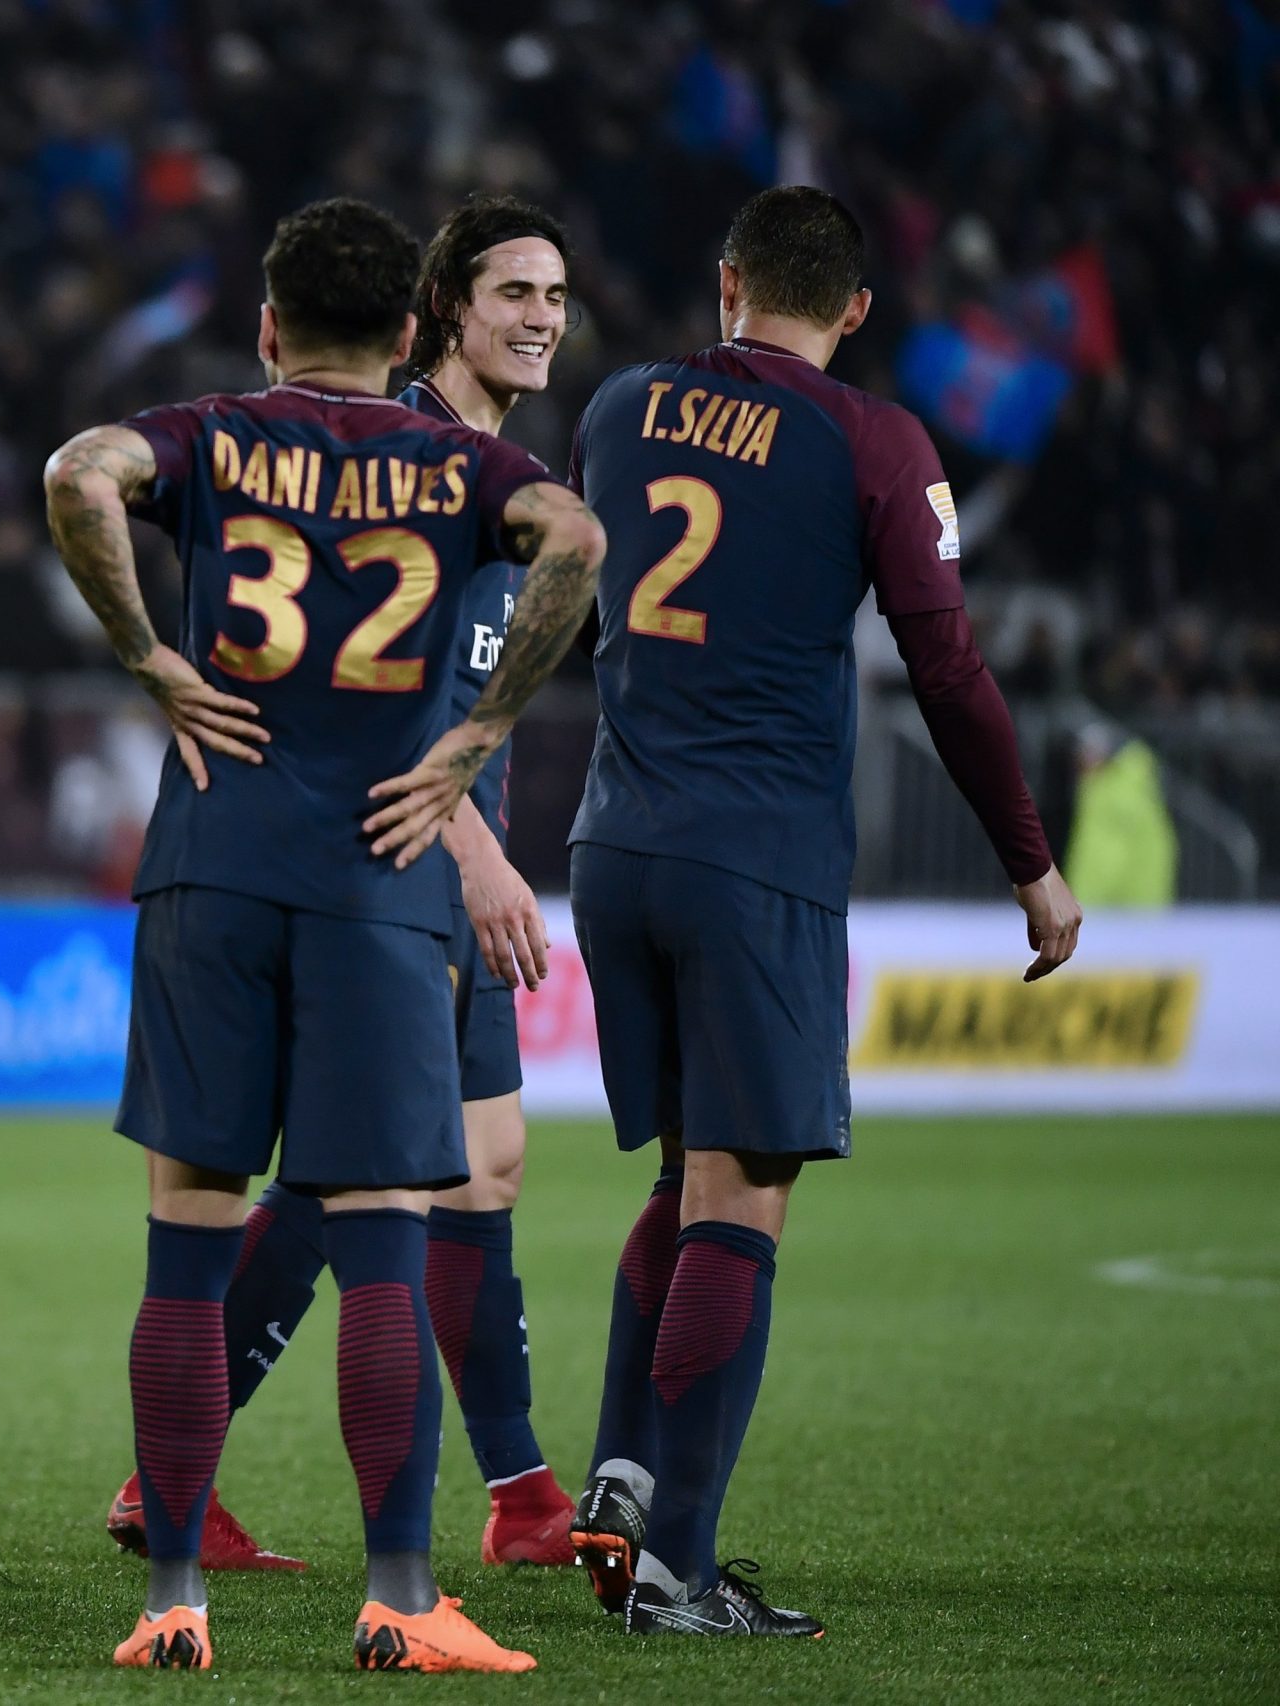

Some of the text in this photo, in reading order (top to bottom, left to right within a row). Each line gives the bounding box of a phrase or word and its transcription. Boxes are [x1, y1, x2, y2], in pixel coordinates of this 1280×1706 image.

[213, 429, 469, 520] DANI ALVES
[641, 381, 780, 467] T.SILVA
[208, 514, 441, 693] 32
[627, 475, 723, 645] 2
